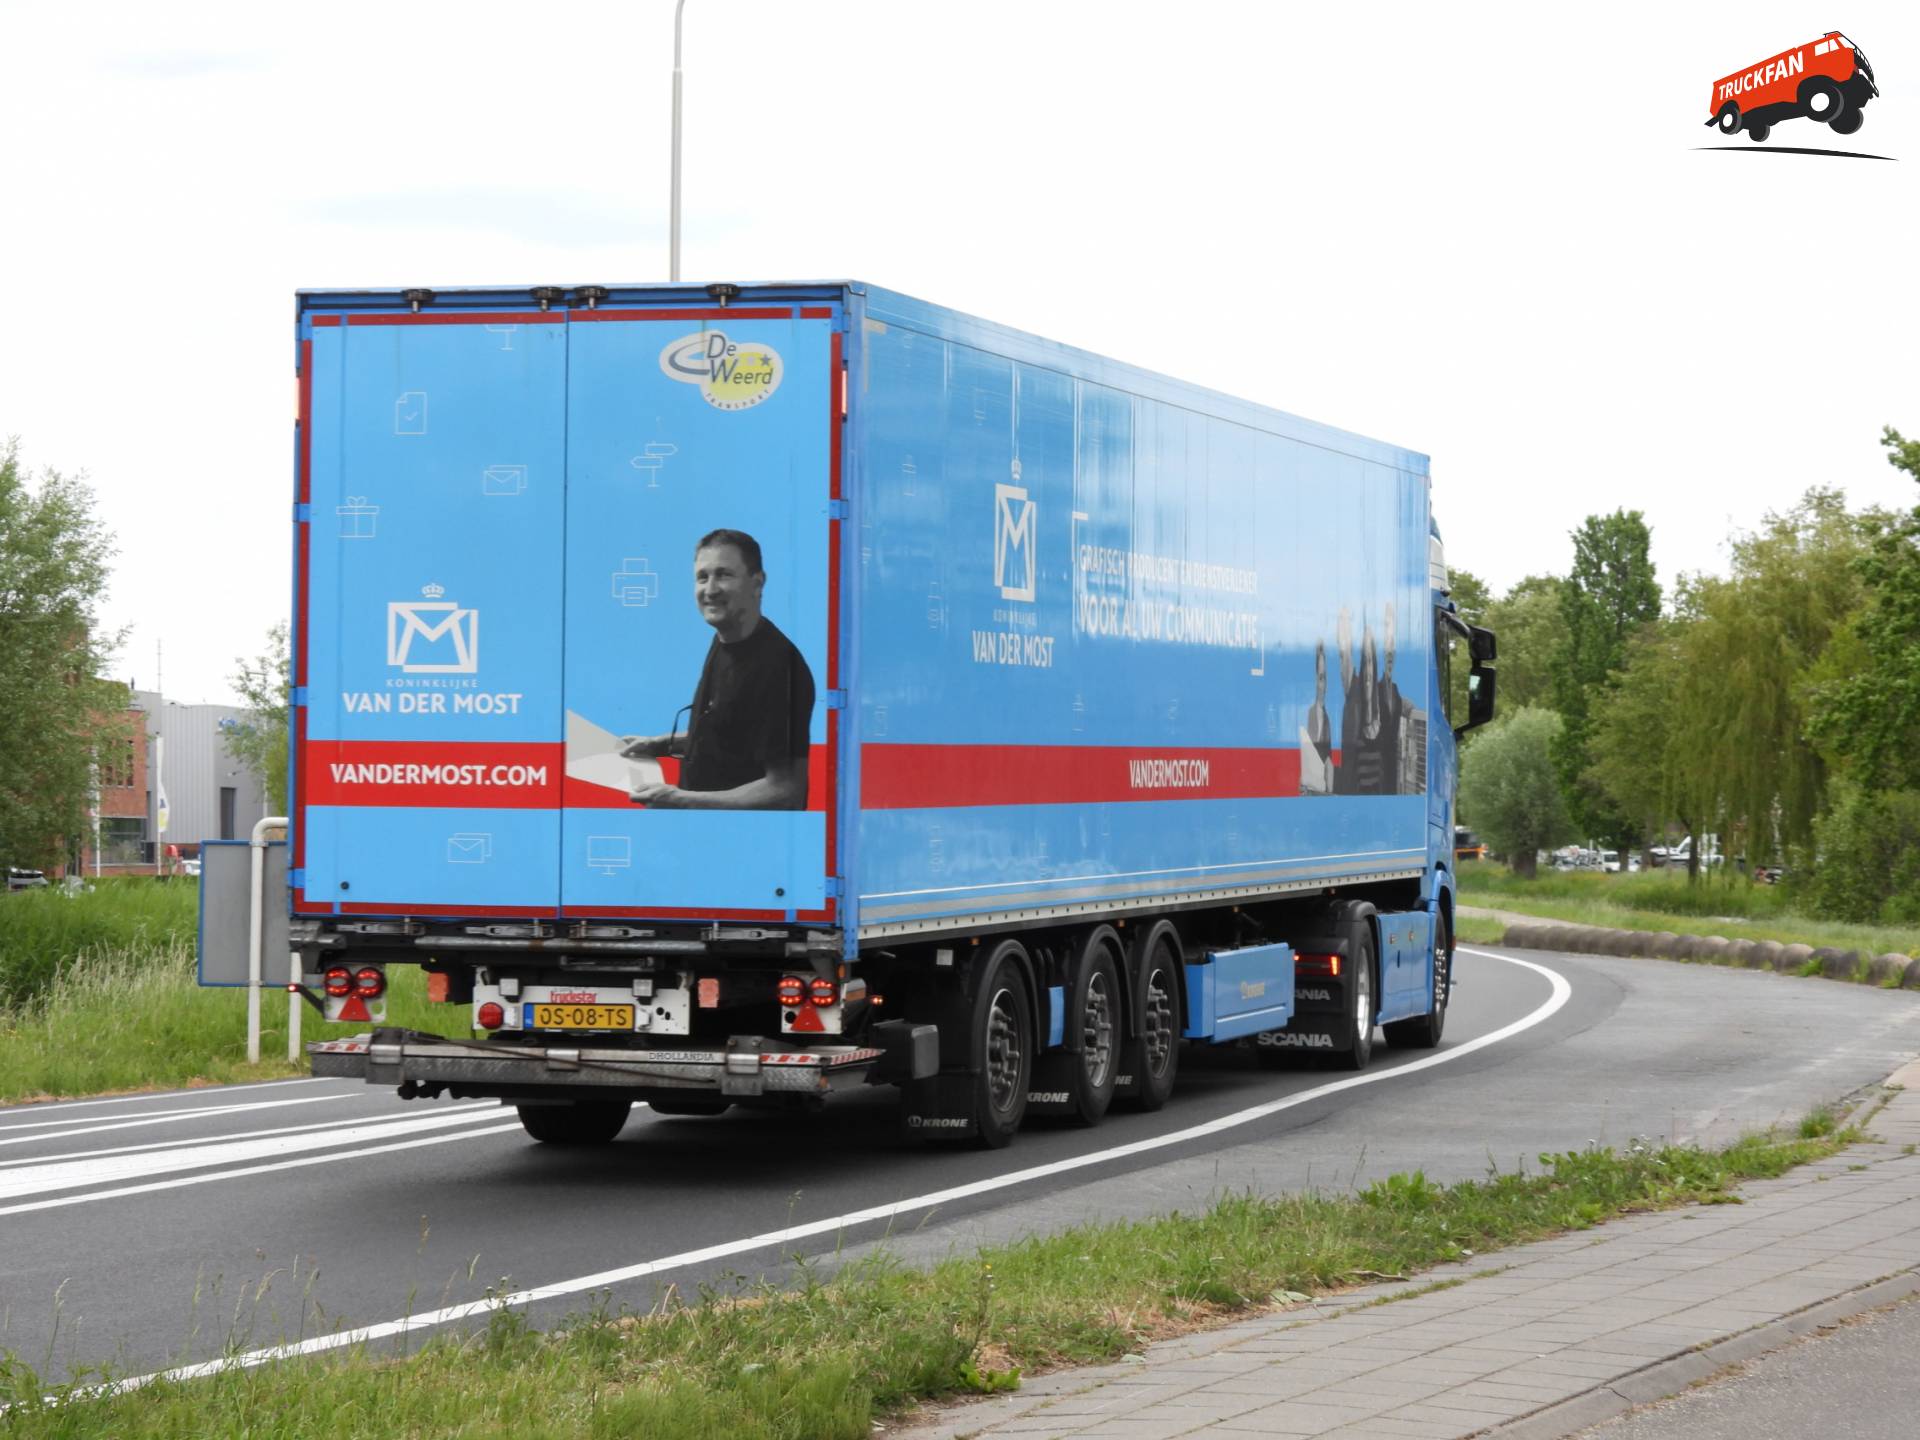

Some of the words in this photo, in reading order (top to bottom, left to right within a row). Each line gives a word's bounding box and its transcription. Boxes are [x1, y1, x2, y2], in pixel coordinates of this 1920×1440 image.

[706, 334, 737, 359] De
[709, 358, 774, 384] Weerd
[1079, 544, 1124, 577] GRAFISCH
[1078, 593, 1118, 636] VOOR
[1141, 601, 1162, 640] UW
[1165, 604, 1258, 649] COMMUNICATIE
[972, 629, 996, 663] VAN
[999, 632, 1021, 665] DER
[1023, 635, 1055, 668] MOST
[386, 679, 479, 689] KONINKLIJKE
[342, 692, 391, 713] VAN
[398, 693, 446, 714] DER
[453, 694, 523, 715] MOST
[330, 763, 547, 786] VANDERMOST.COM
[1128, 759, 1210, 788] VANDERMOST.COM
[1296, 988, 1330, 1001] ANIA
[540, 1007, 627, 1026] OS-08-TS
[1257, 1032, 1333, 1047] SCANIA
[648, 1052, 714, 1062] DHOLLANDIA
[922, 1118, 968, 1128] KRONE
